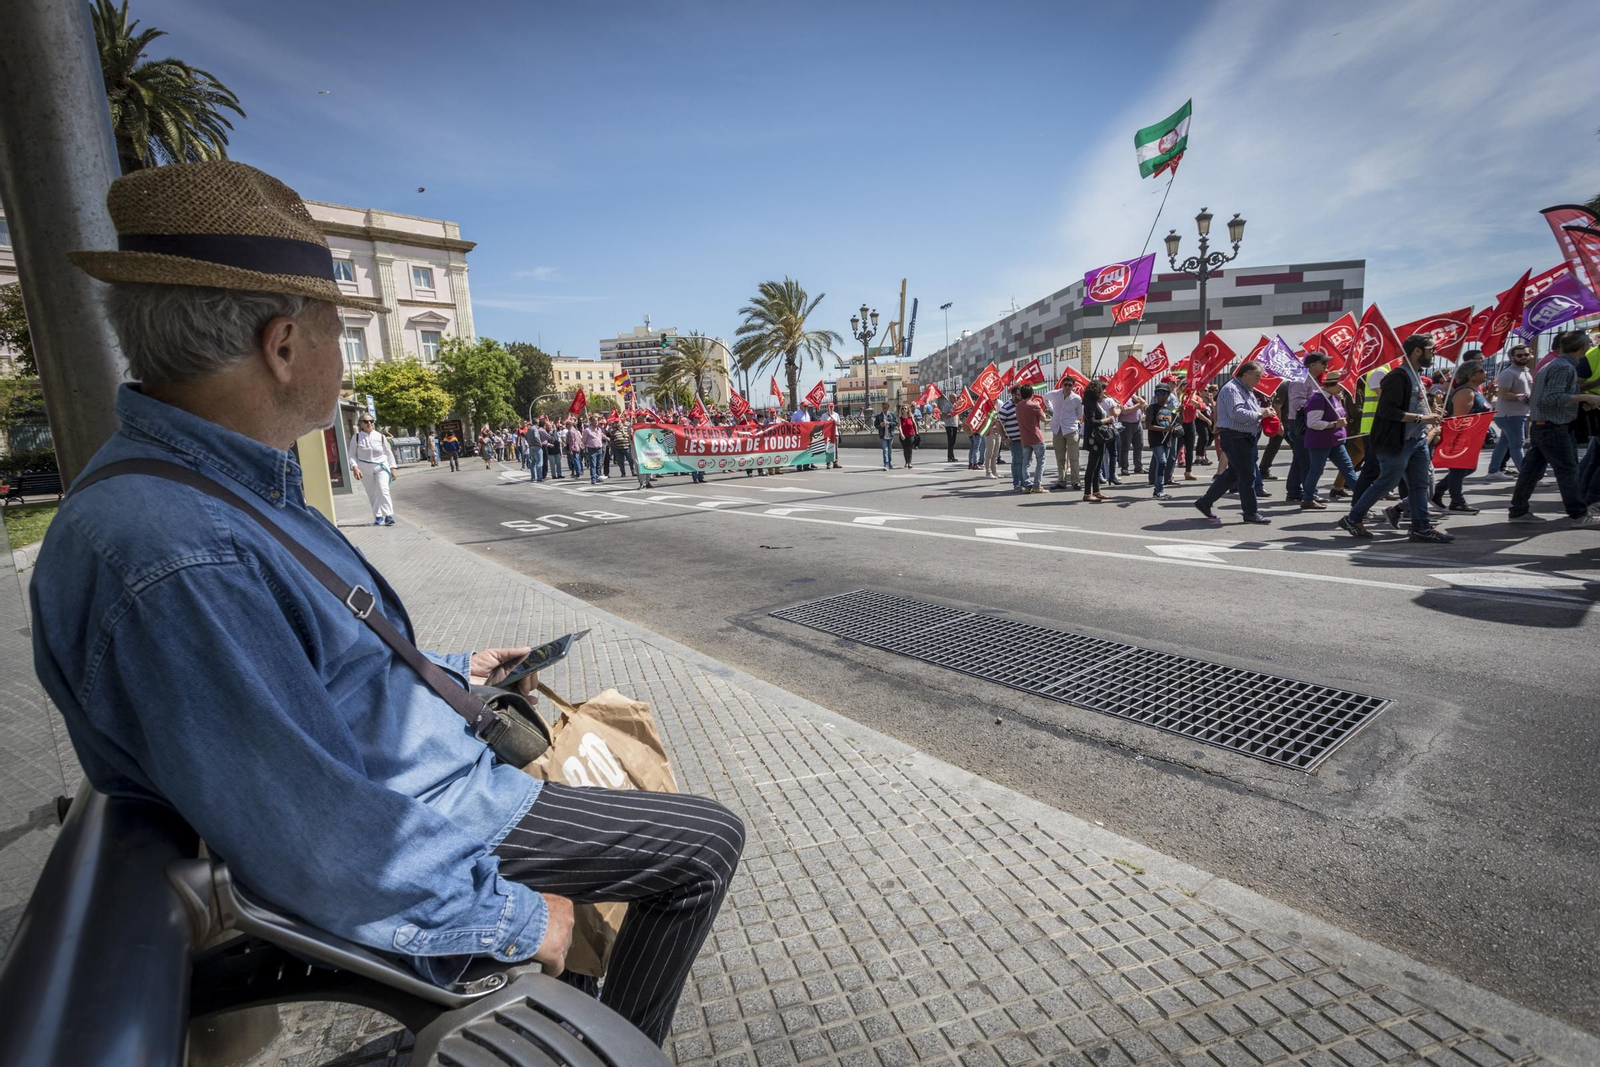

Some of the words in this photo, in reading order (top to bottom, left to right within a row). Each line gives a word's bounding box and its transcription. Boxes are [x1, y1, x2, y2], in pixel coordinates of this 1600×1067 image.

[684, 427, 732, 439] DEFENDER
[711, 438, 742, 453] COSA
[746, 436, 760, 452] DE
[500, 510, 630, 532] BUS
